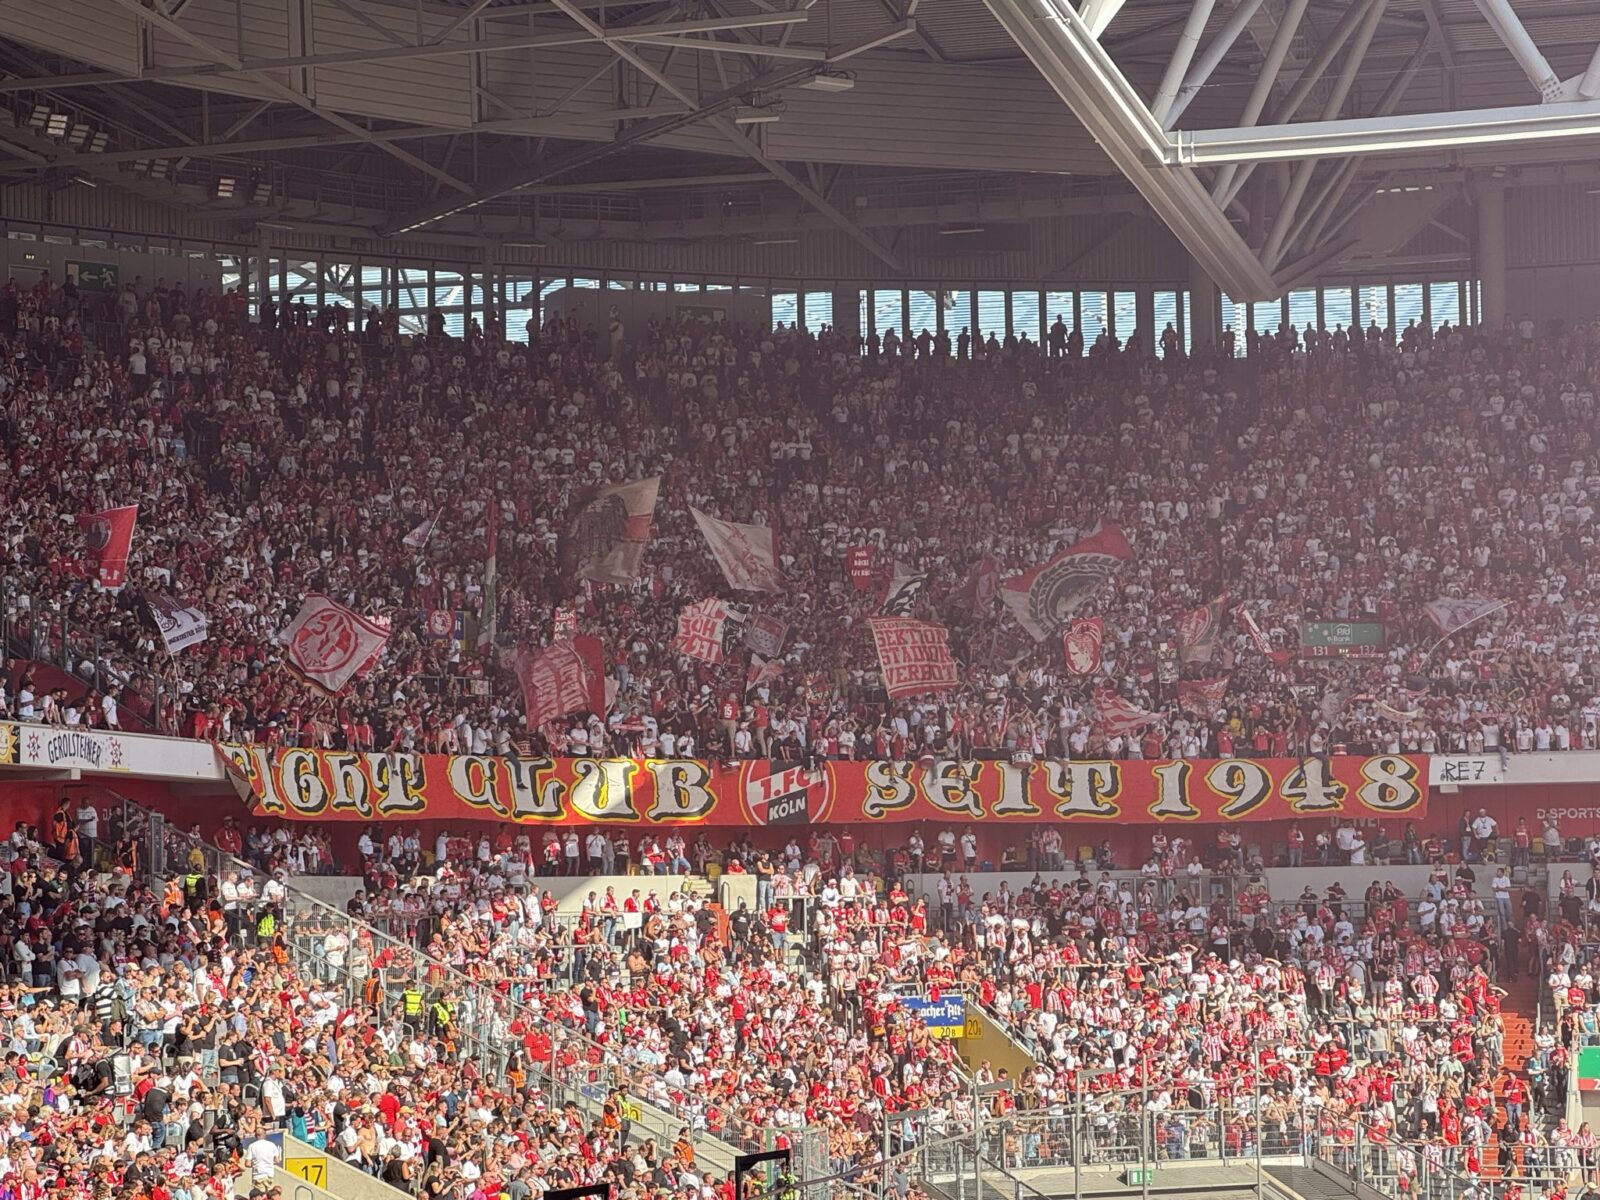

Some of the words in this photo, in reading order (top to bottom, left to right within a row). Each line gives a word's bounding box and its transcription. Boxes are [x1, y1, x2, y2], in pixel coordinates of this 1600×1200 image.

[875, 627, 948, 647] SEKTION
[1312, 646, 1329, 656] 131
[47, 733, 102, 768] GEROLSTEINER
[449, 756, 717, 822] CLUB
[864, 759, 1123, 819] SEIT
[1148, 756, 1423, 821] 1948
[769, 797, 806, 821] KÖLN
[301, 1165, 324, 1186] 17
